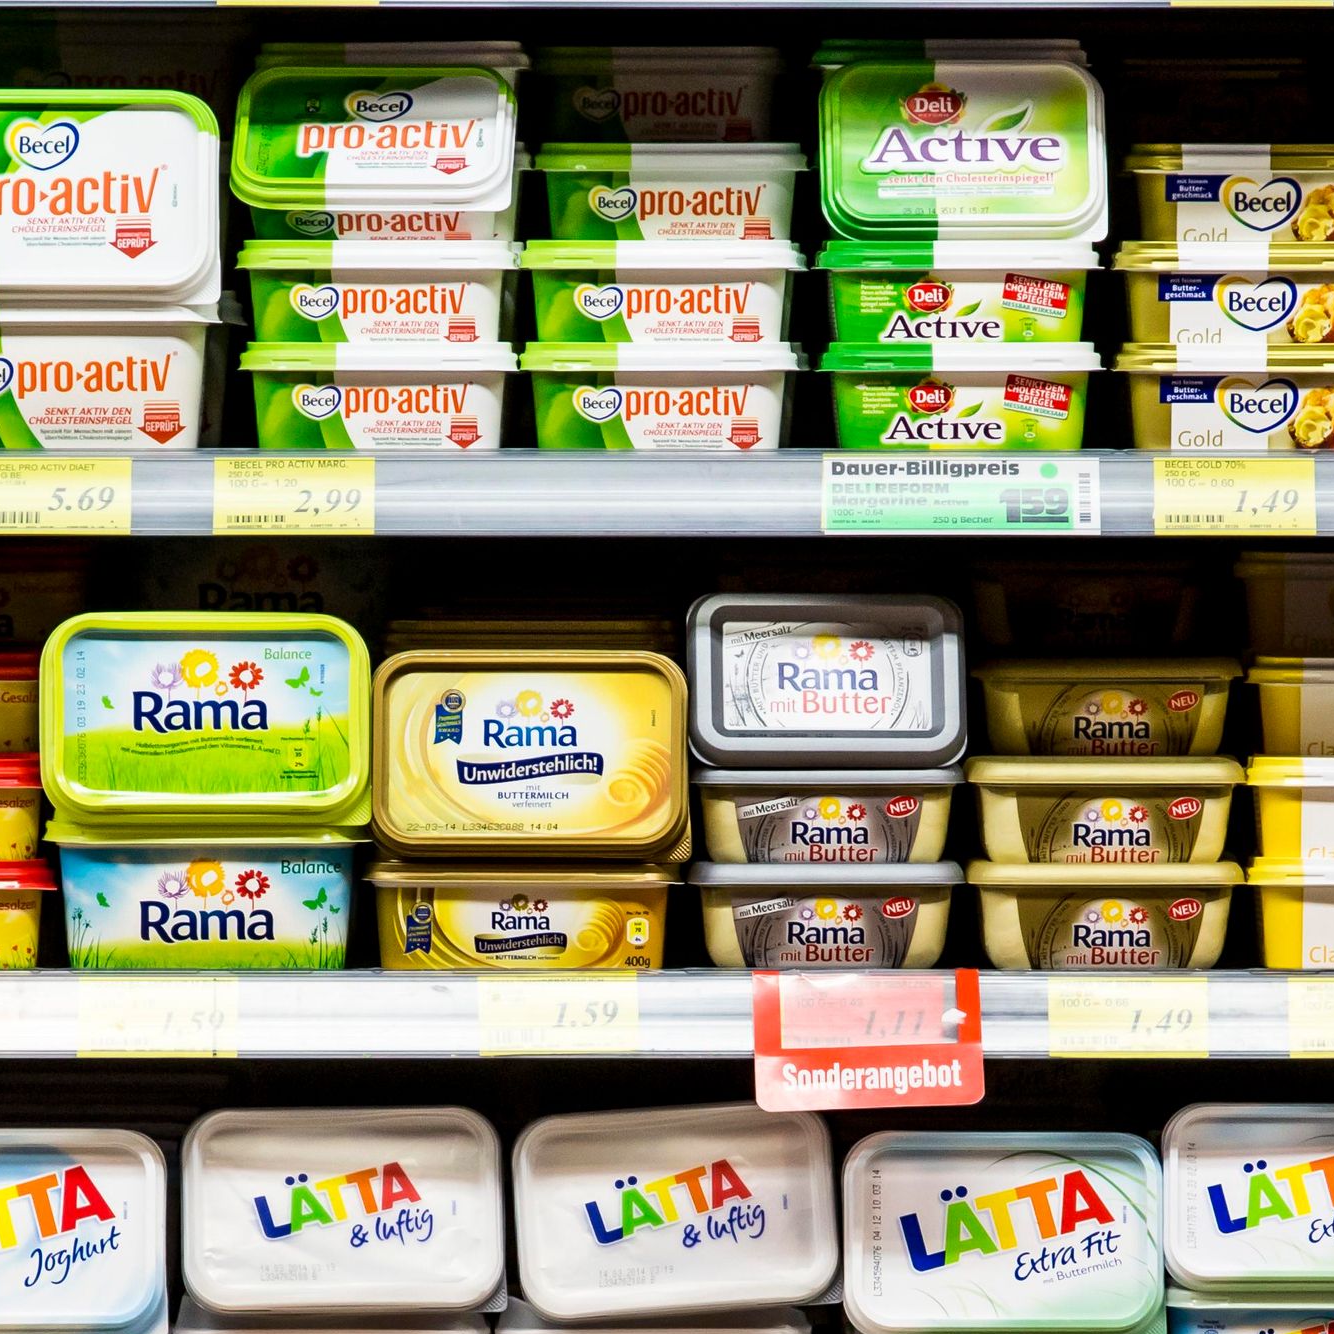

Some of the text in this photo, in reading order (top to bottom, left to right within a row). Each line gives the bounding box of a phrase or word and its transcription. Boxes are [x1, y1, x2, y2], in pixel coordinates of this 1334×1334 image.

[913, 98, 955, 115] Deli
[18, 134, 71, 156] Becel
[870, 127, 1061, 163] Active
[45, 408, 133, 416] SENKT AKTIV DEN
[1229, 392, 1289, 414] Becel
[28, 416, 133, 425] CHOLESTERINSPIEGEL
[831, 461, 1019, 479] Dauer-Billigpreis
[1165, 461, 1195, 469] BECEL
[293, 489, 362, 515] 2,99
[1234, 490, 1298, 513] 1,49
[132, 691, 268, 731] Rama
[769, 689, 891, 714] mit Butter
[483, 718, 577, 748] Rama
[463, 754, 598, 782] Unwiderstehlich!
[497, 791, 568, 801] BUTTERMILCH
[281, 859, 342, 874] Balance
[886, 899, 909, 914] NEU
[1073, 922, 1149, 948] Rama
[1067, 946, 1160, 965] mit Butter
[1130, 1009, 1193, 1034] 1,49
[782, 1059, 961, 1091] Sonderangebot
[253, 1162, 422, 1239] LÄTTA
[350, 1208, 435, 1248] & luftig
[899, 1170, 1115, 1271] LÄTTA
[24, 1226, 121, 1286] Joghurt
[1015, 1231, 1121, 1281] Extra Fit
[1056, 1258, 1122, 1281] Buttermilch
